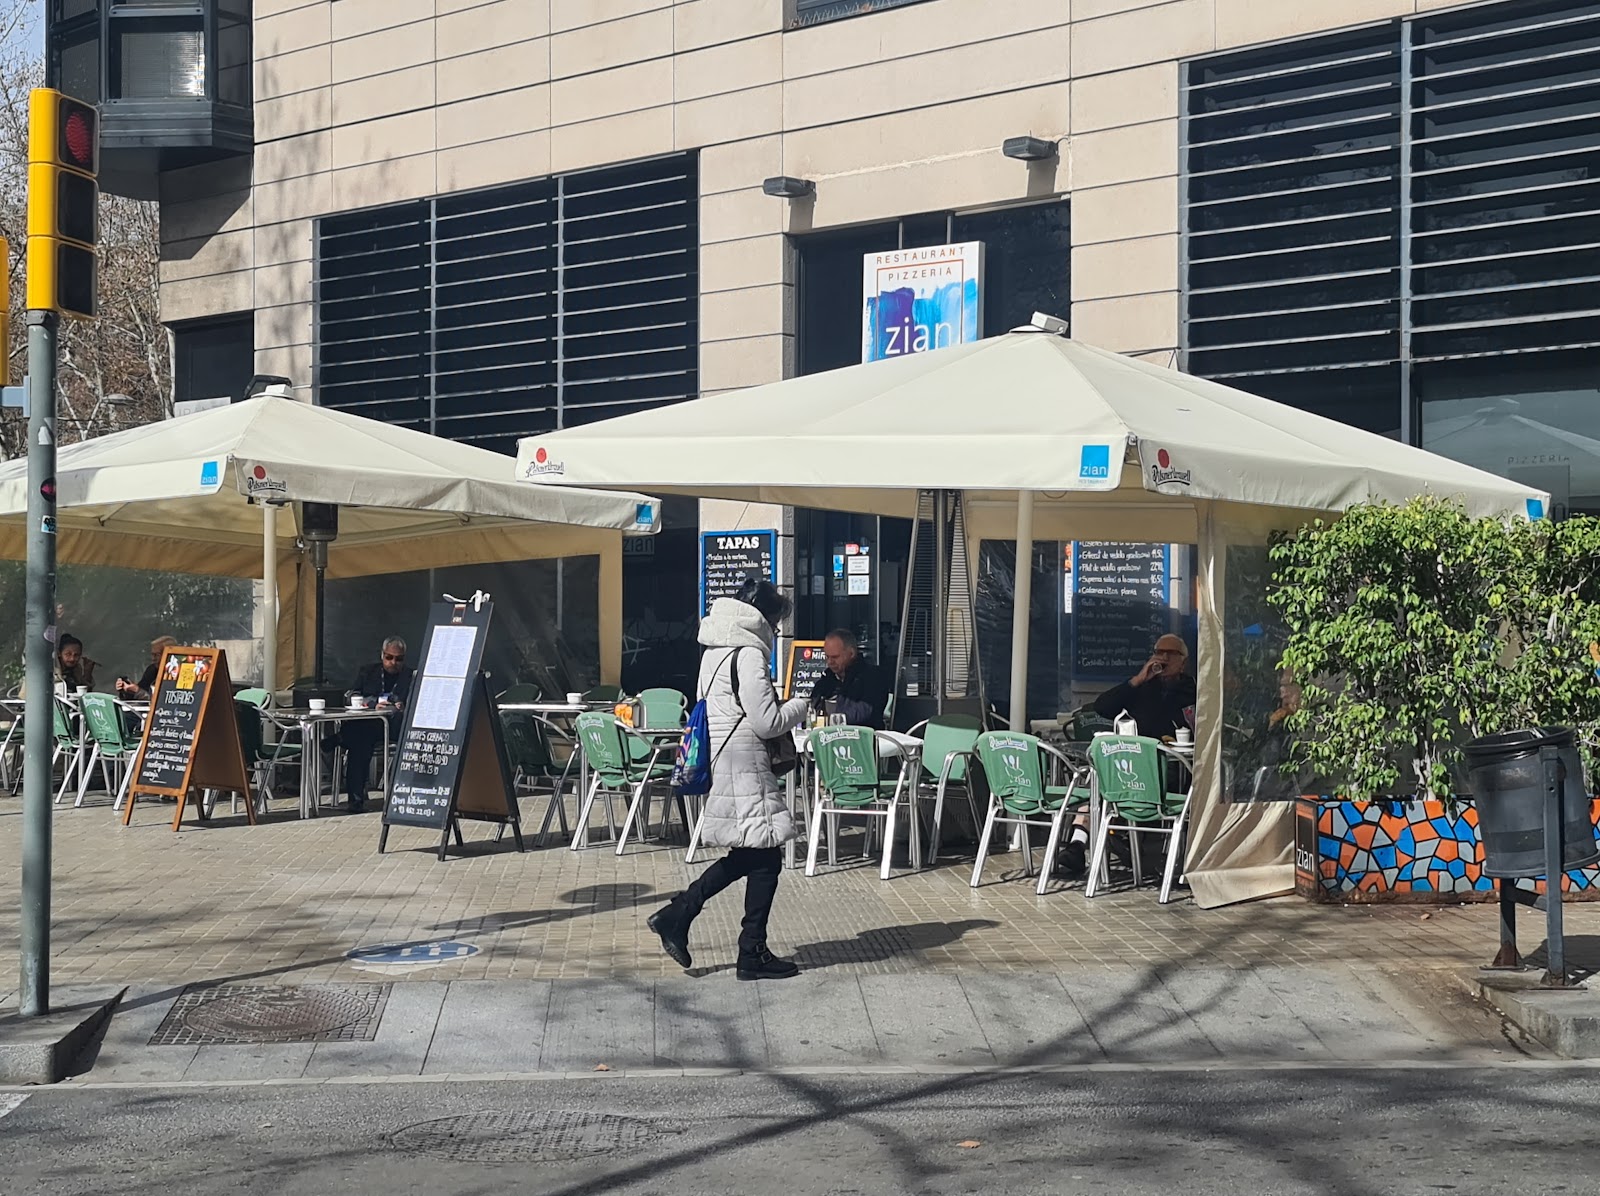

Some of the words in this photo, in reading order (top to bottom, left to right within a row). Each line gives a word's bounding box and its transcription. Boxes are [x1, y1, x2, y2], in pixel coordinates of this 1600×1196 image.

[876, 246, 965, 265] RESTAURANT
[888, 267, 952, 281] PIZZERIA
[885, 316, 952, 355] zian
[1081, 464, 1107, 476] zian
[716, 536, 760, 549] TAPAS
[811, 651, 828, 660] MIR
[1297, 844, 1314, 872] zian
